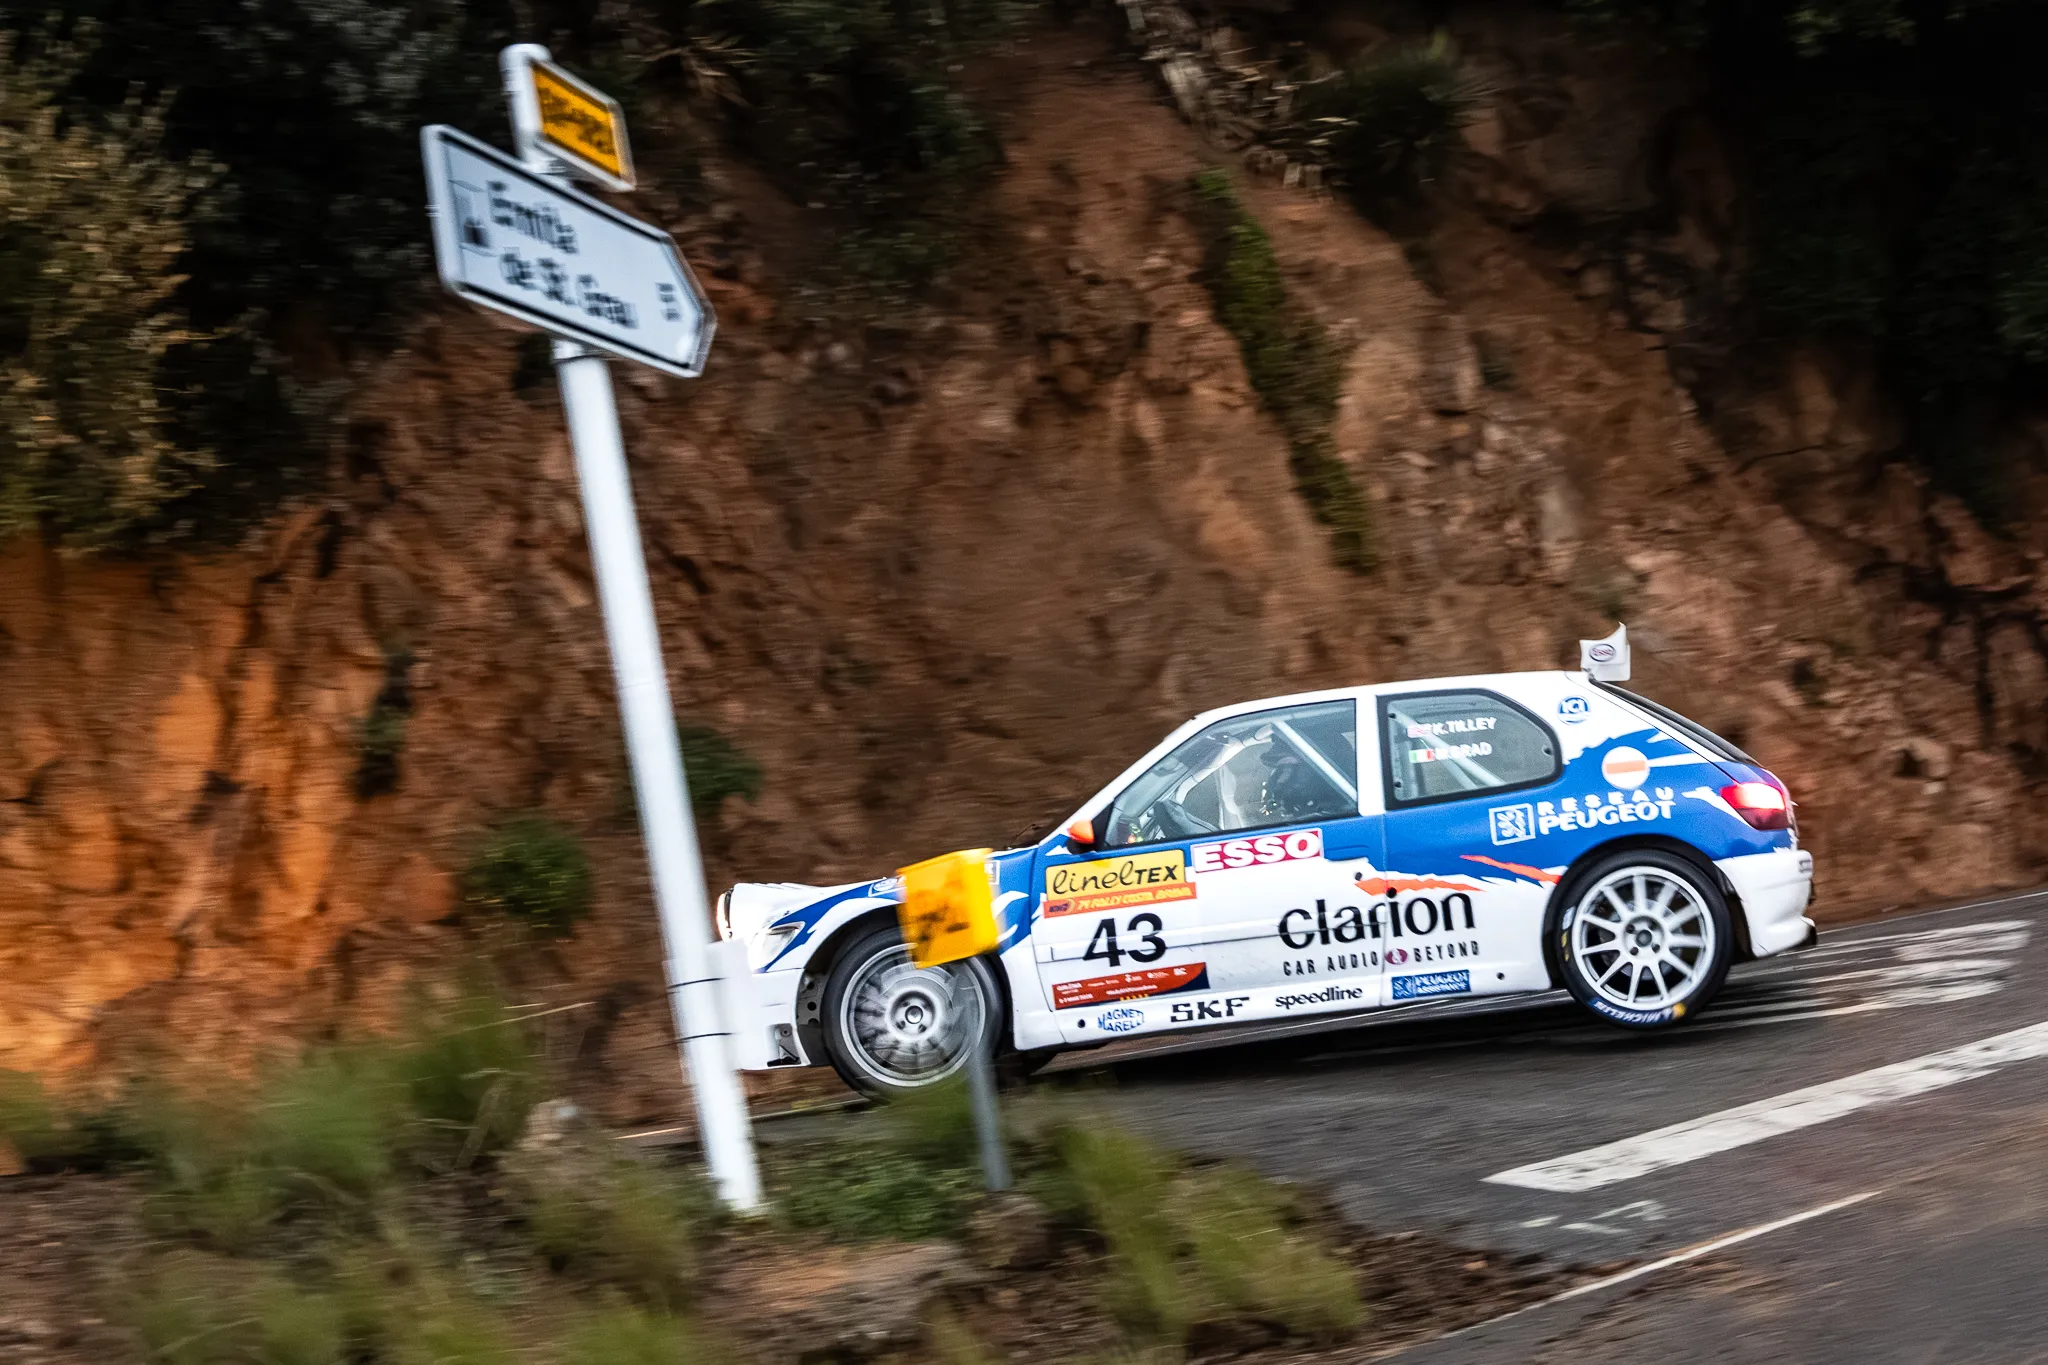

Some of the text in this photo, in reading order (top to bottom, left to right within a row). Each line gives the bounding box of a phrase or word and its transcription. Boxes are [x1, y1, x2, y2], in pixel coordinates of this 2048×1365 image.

[1536, 786, 1675, 817] RESEAU
[1538, 799, 1676, 835] PEUGEOT
[1194, 832, 1321, 873] ESSO
[1082, 912, 1168, 968] 43
[1283, 959, 1317, 977] CAR
[1326, 951, 1379, 972] AUDIO
[1412, 941, 1481, 962] BEYOND
[1170, 996, 1250, 1023] SKF
[1274, 985, 1364, 1010] speedline
